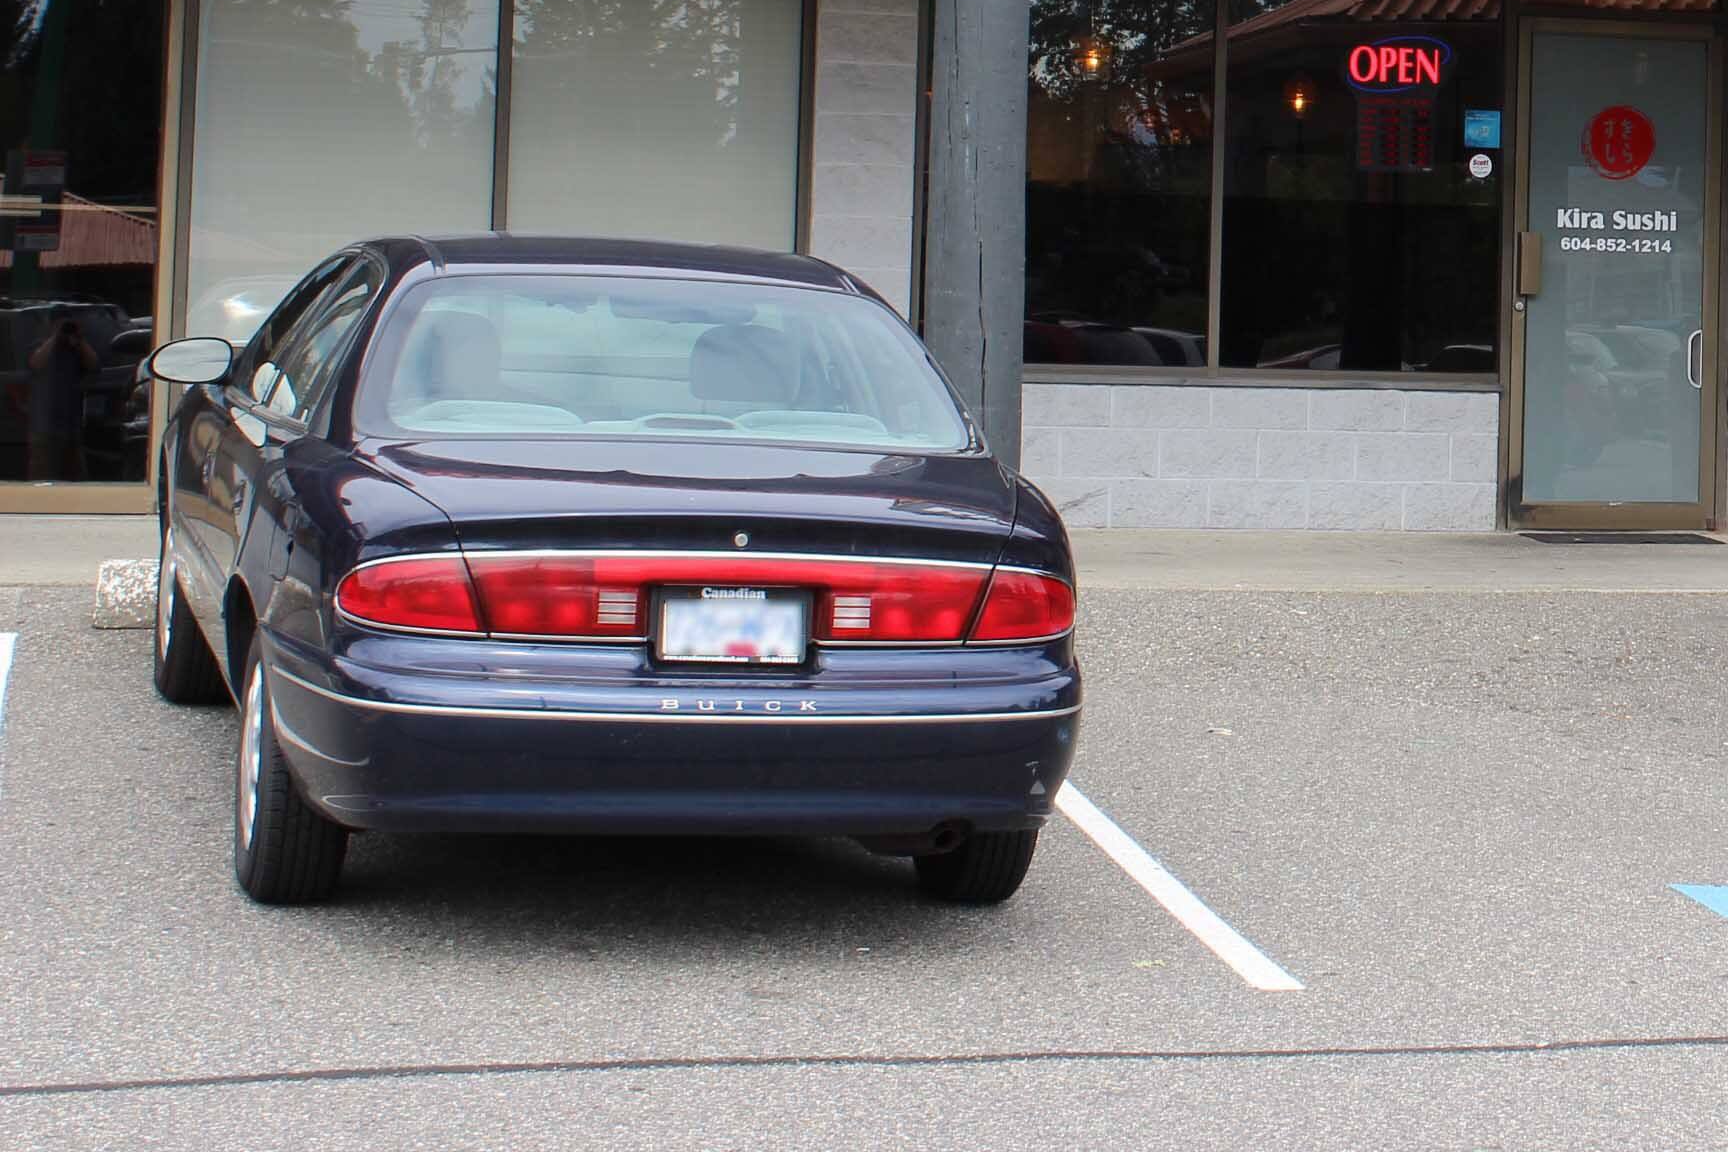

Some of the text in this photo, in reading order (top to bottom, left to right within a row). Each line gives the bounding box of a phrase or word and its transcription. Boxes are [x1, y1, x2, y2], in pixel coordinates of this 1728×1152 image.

[1349, 45, 1440, 85] OPEN
[1557, 208, 1677, 231] Kira Sushi
[1560, 237, 1672, 253] 604-852-1214
[701, 587, 767, 600] Canadian
[660, 698, 817, 712] BUICK
